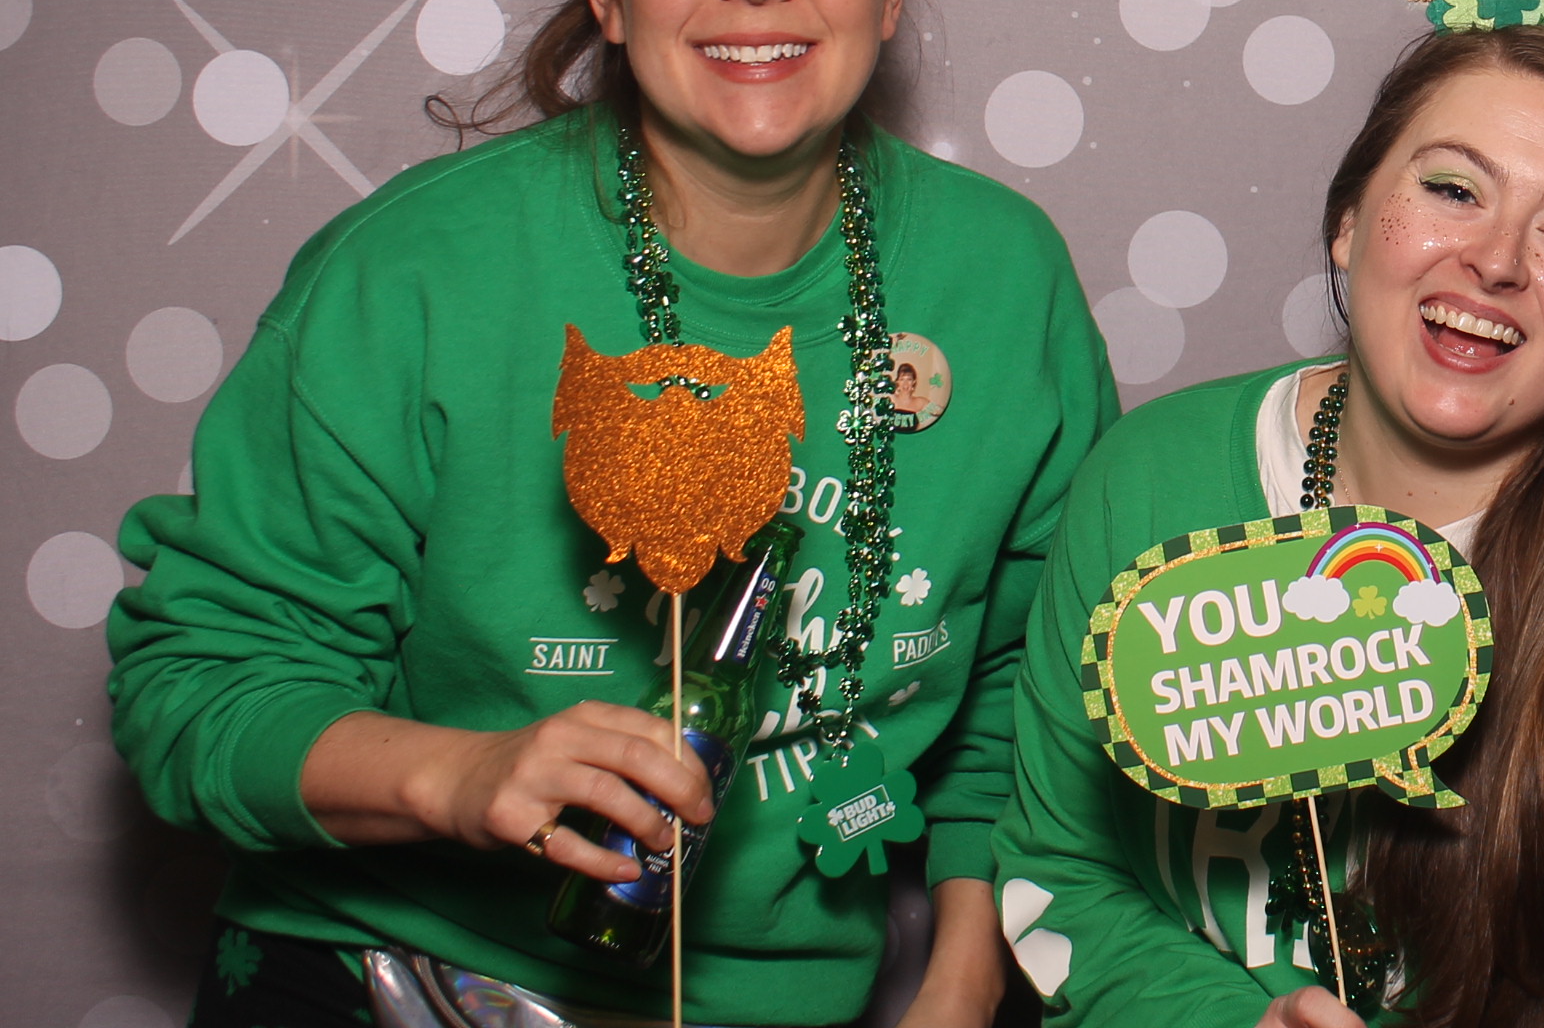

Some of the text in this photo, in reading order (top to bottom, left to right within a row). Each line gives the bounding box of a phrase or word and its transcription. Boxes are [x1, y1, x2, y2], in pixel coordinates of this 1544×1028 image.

[736, 611, 761, 658] Heineken
[1137, 579, 1283, 654] YOU
[532, 643, 610, 669] SAINT
[1150, 624, 1431, 715] SHAMROCK
[1163, 678, 1436, 767] MY WORLD
[841, 802, 888, 836] LIGHT
[843, 794, 878, 821] BUD
